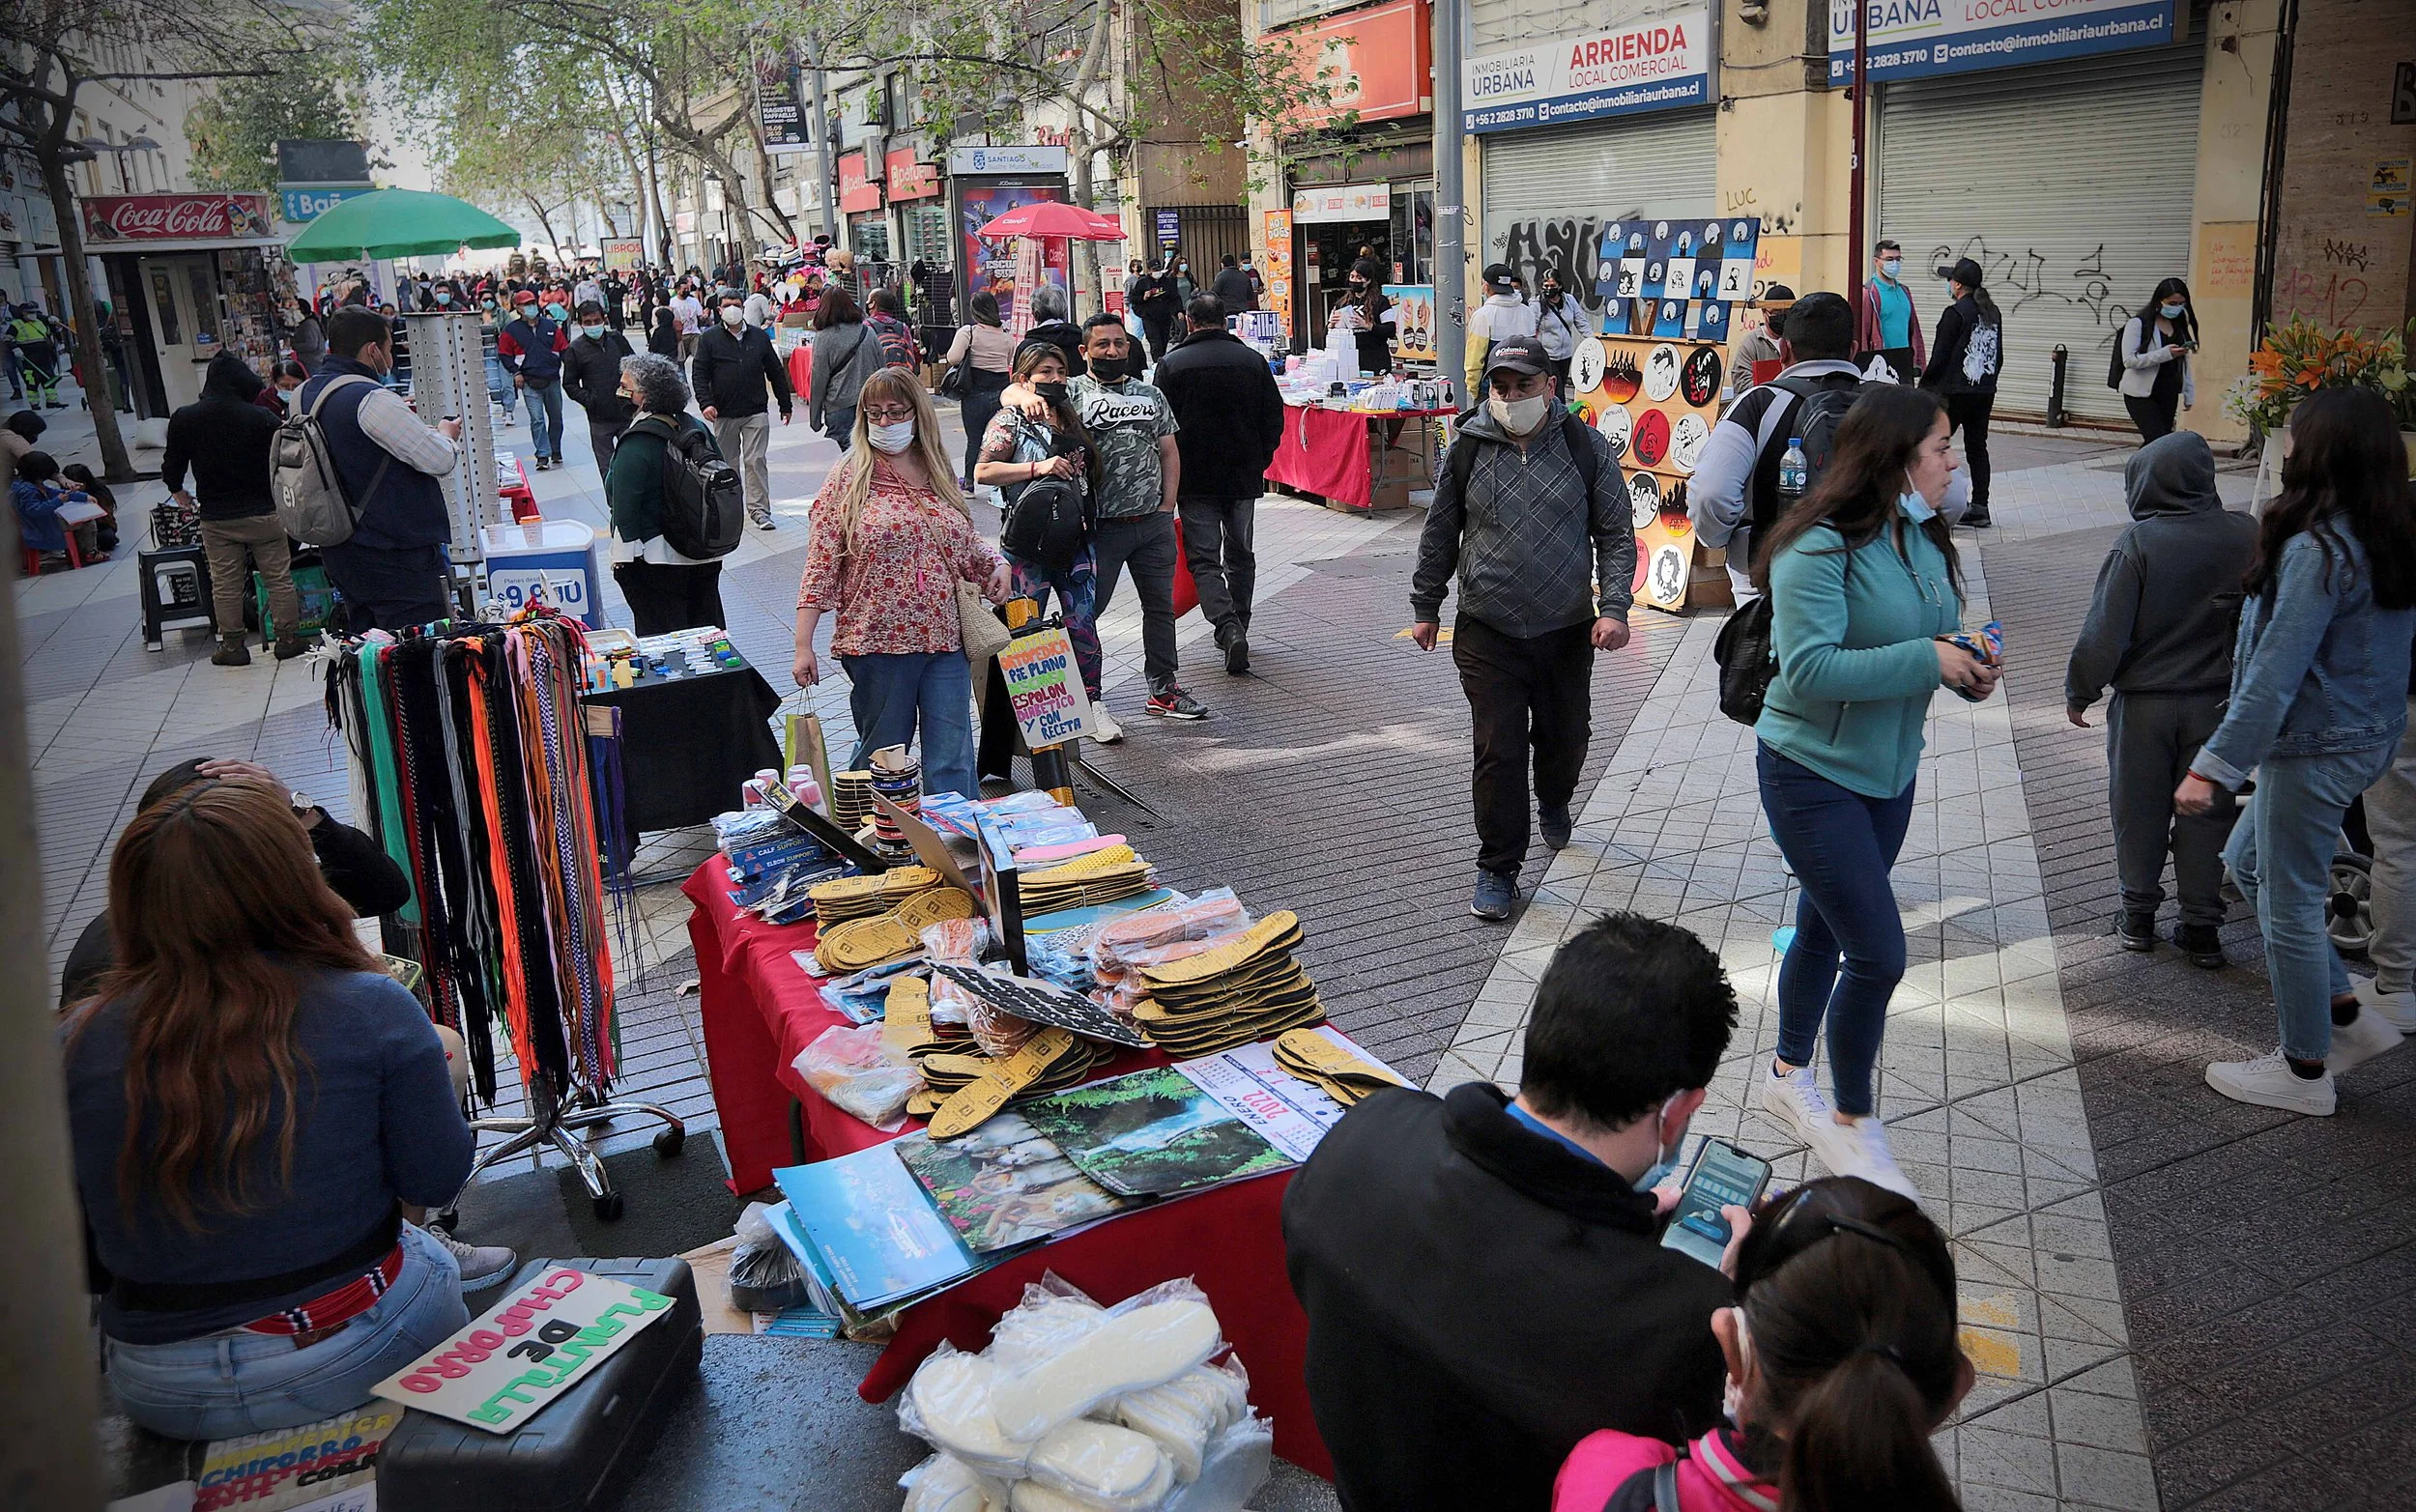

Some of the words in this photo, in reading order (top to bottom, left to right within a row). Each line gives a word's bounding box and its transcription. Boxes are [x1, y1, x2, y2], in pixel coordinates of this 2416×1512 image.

[1833, 0, 1941, 35] UBANA
[1569, 24, 1687, 70] ARRIENDA
[1949, 14, 2163, 58] contacto@inmobiliariaurbana.cl
[1472, 54, 1535, 74] INMOBILIARIA
[1569, 72, 1607, 89] LOCAL
[1610, 55, 1687, 85] COMERCIAL
[1866, 58, 1873, 69] 2
[1874, 53, 1901, 69] 2828
[1902, 49, 1928, 64] 3710
[1473, 70, 1536, 97] URBANA
[1550, 81, 1699, 115] contacto@inmobiliariaurbana.cl
[1475, 115, 1489, 125] +56
[1489, 115, 1495, 124] 2
[1496, 111, 1515, 123] 2828
[1516, 107, 1535, 120] 3710
[1268, 228, 1290, 241] DOGS
[1269, 218, 1284, 229] HOT
[605, 242, 642, 254] LIBROS
[1084, 397, 1157, 427] Racers
[1027, 655, 1067, 678] PLANO
[1011, 681, 1068, 710] ESPOLON
[1024, 718, 1035, 734] Y
[1039, 709, 1061, 727] CON
[1041, 717, 1082, 740] RECETA
[758, 846, 776, 857] CALF
[776, 838, 806, 851] SUPPORT
[766, 858, 785, 868] ELBOW
[786, 849, 815, 863] SUPPORT
[1223, 1095, 1268, 1127] ENERO
[1242, 1089, 1289, 1120] 2022
[398, 1269, 584, 1393] CHIPORRO
[506, 1318, 582, 1363] DE
